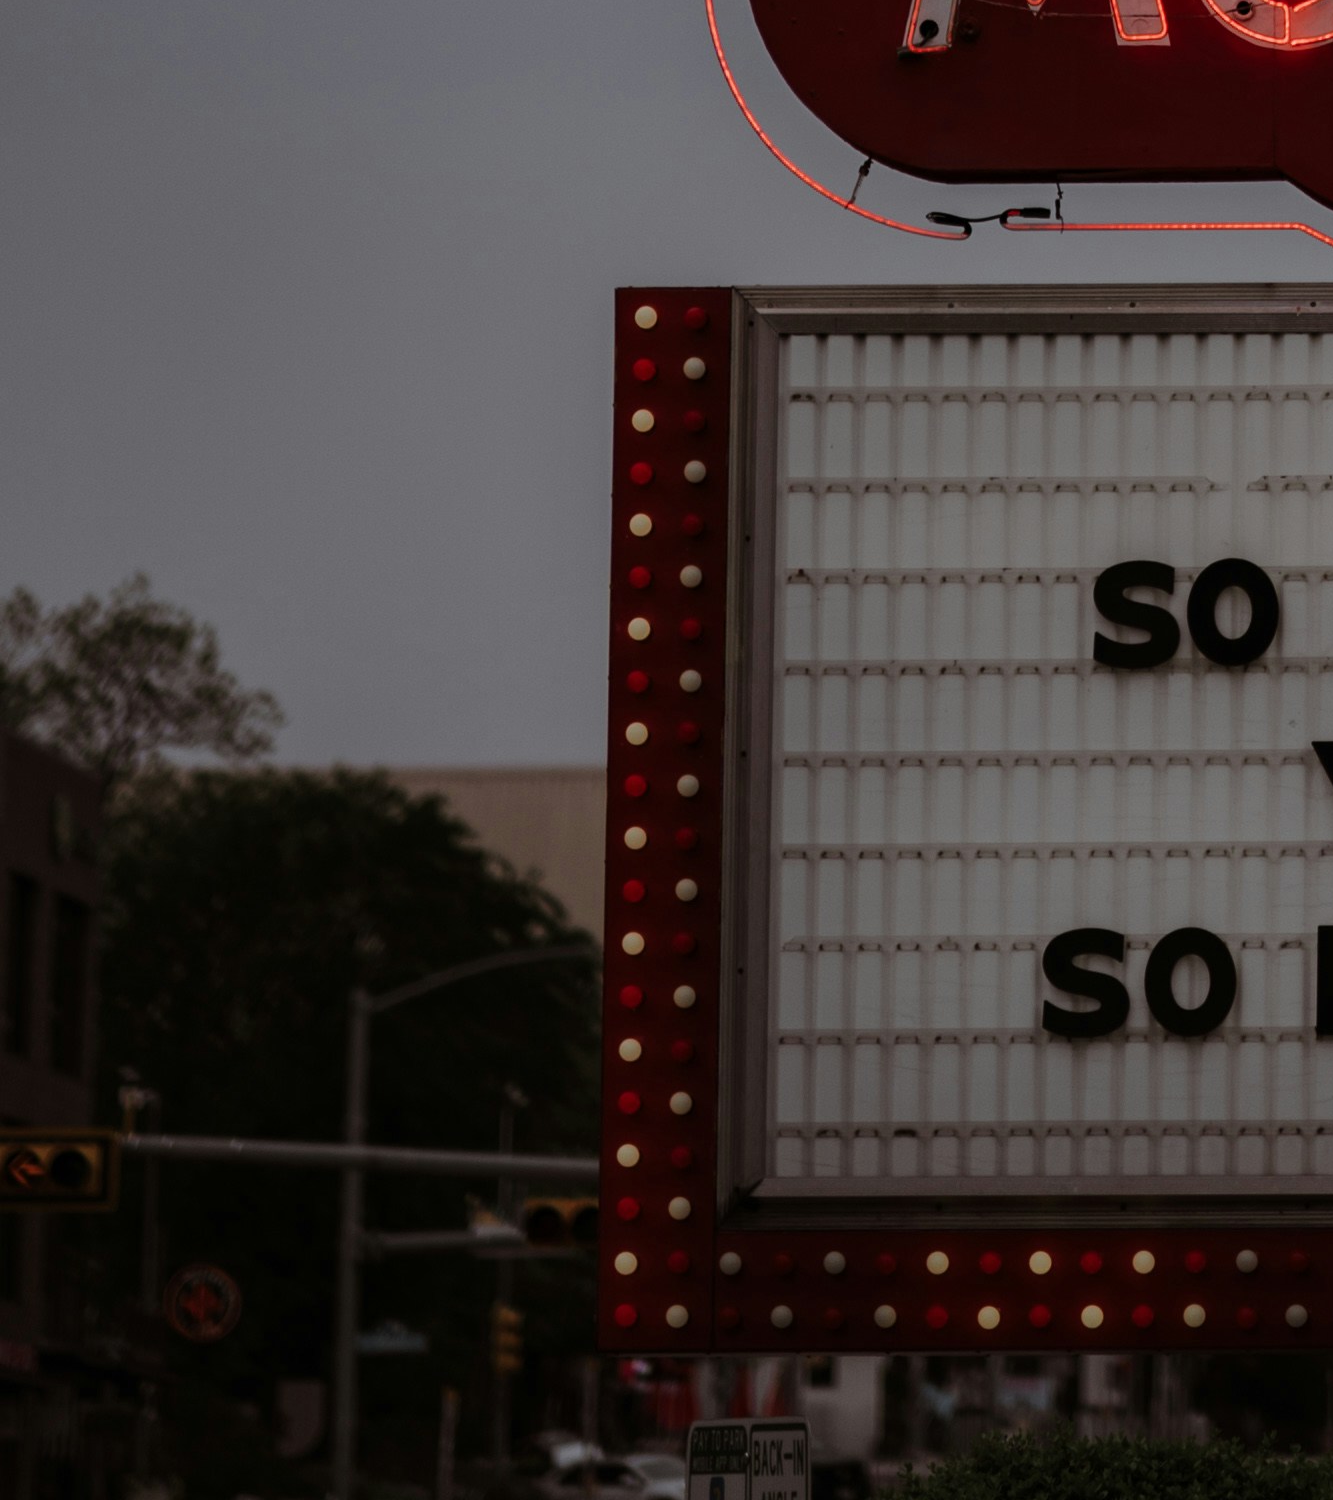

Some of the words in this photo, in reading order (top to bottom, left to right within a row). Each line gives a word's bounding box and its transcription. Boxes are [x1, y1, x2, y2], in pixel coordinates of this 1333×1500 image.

[1094, 559, 1279, 671] SO
[1043, 928, 1236, 1042] SO
[692, 1430, 708, 1452] PAY
[711, 1430, 721, 1451] TO
[723, 1429, 745, 1451] PARK
[753, 1439, 804, 1476] BACK-IN
